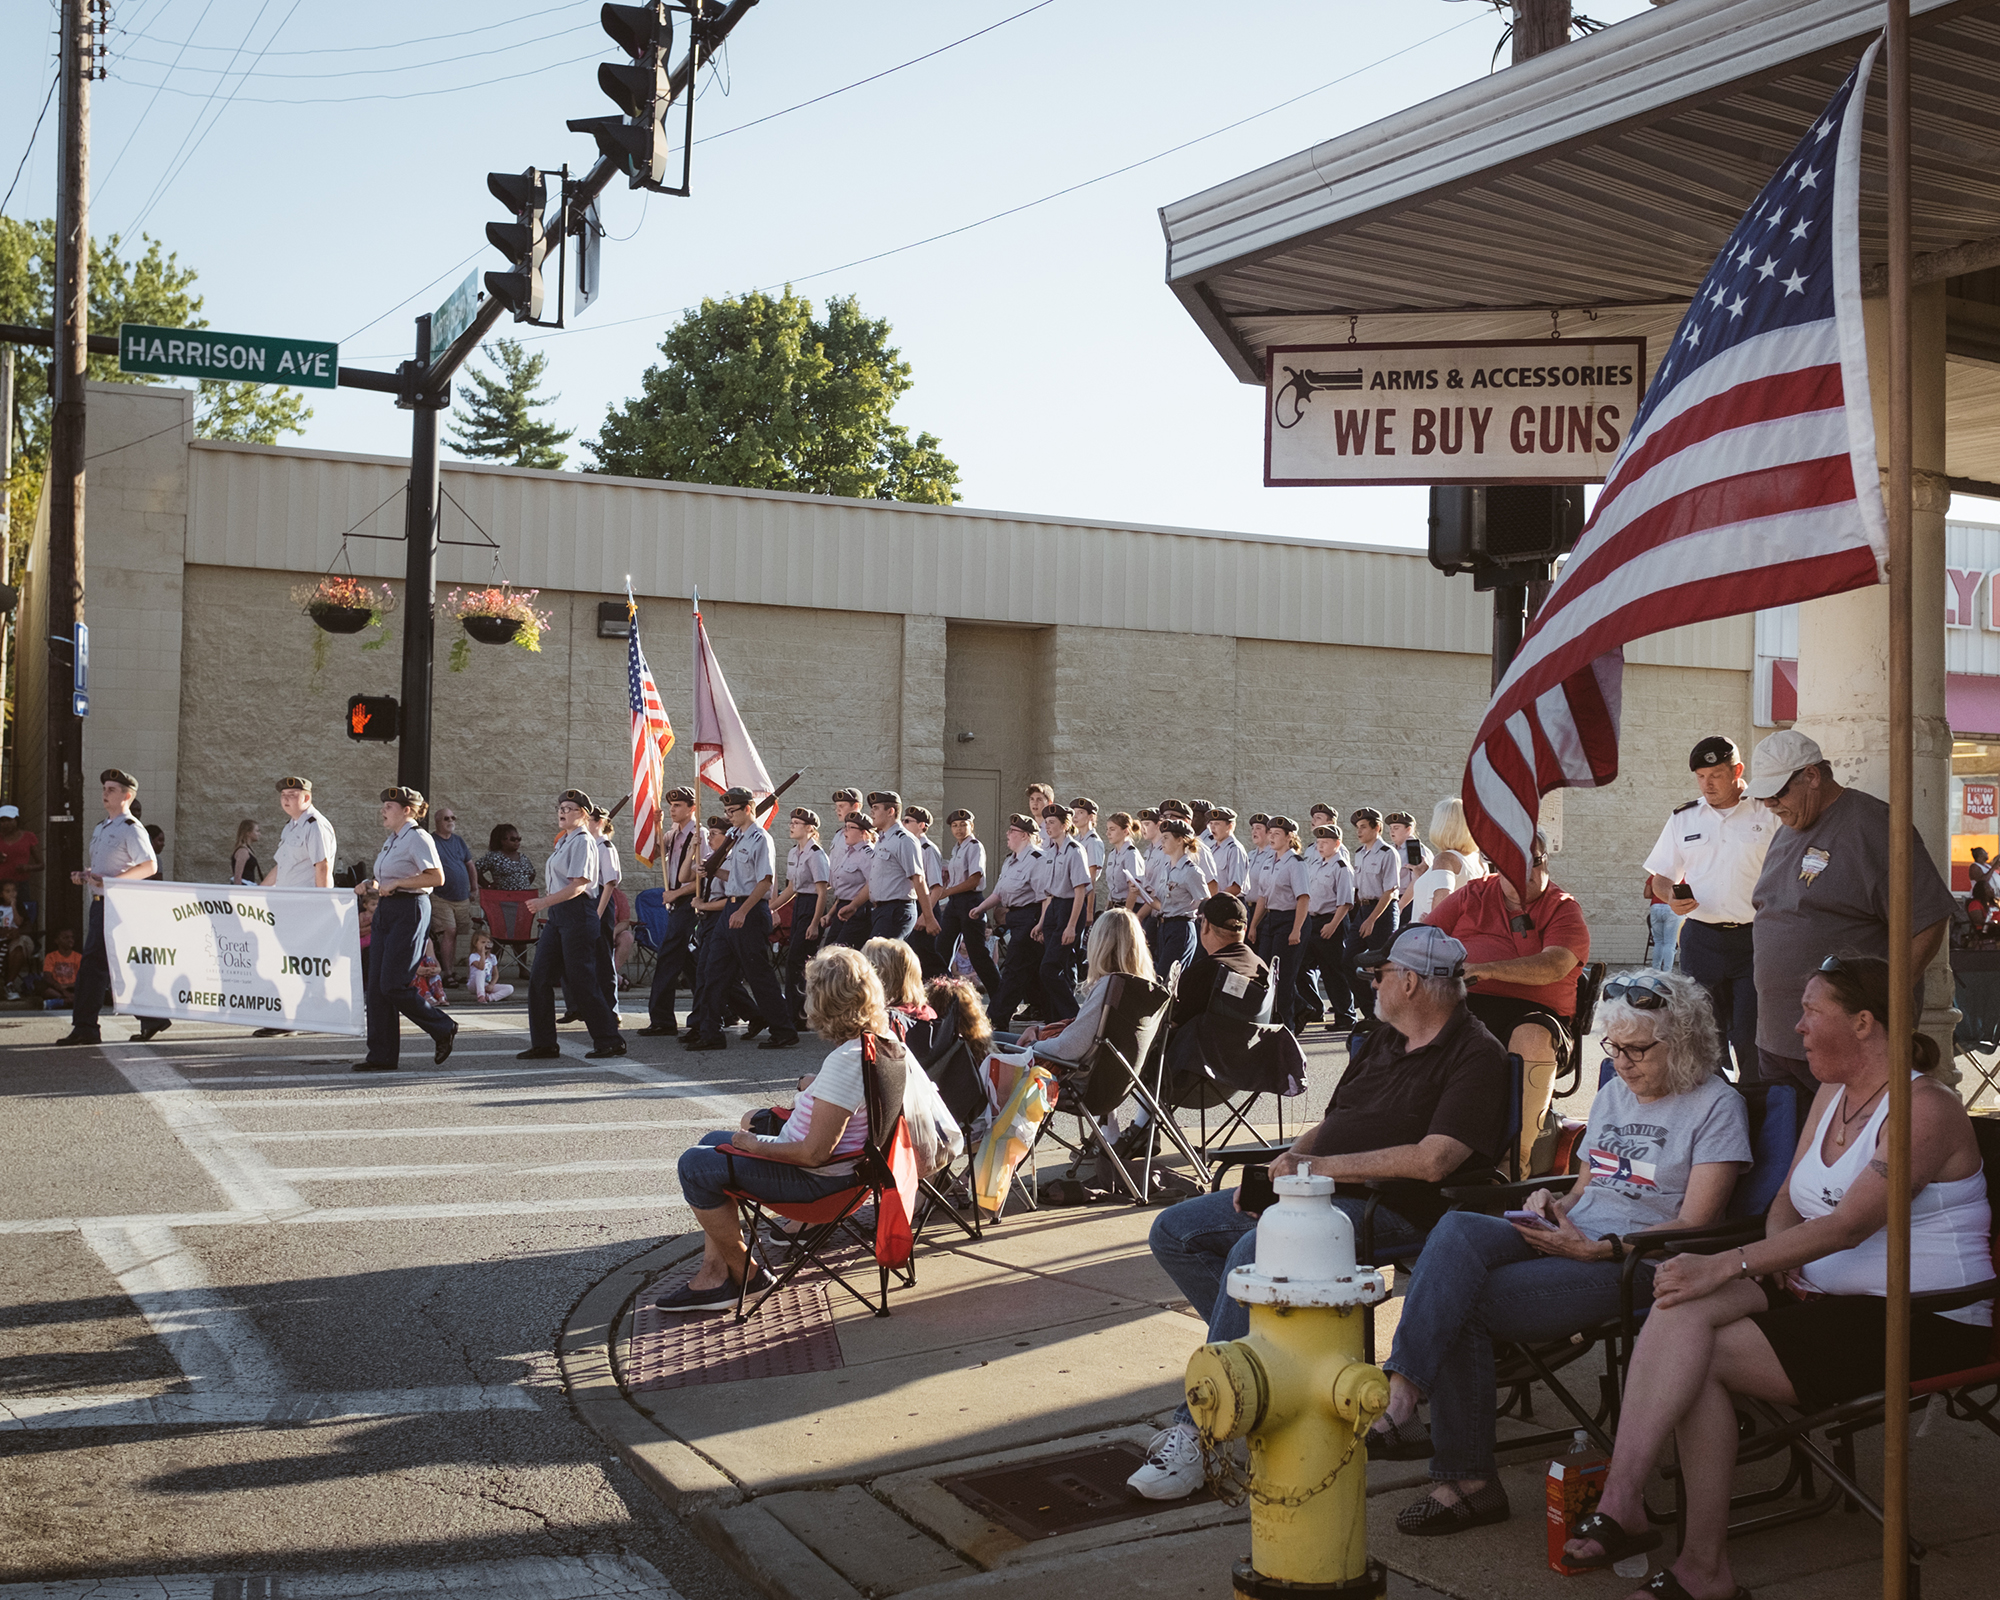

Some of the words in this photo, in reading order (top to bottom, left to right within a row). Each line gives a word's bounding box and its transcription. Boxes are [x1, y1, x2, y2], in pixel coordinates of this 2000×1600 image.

[127, 336, 266, 373] HARRISON
[276, 350, 330, 378] AVE
[1369, 370, 1439, 391] ARMS
[1446, 368, 1464, 389] &
[1470, 365, 1634, 389] ACCESSORIES
[1333, 408, 1397, 456] WE
[1411, 406, 1494, 455] BUY
[1508, 404, 1622, 454] GUNS
[1966, 805, 1994, 815] PRICES
[1967, 793, 1994, 806] LOW
[172, 900, 234, 922] DIAMOND
[236, 902, 276, 927] OAKS
[218, 935, 250, 953] Great
[126, 946, 177, 966] ARMY
[223, 951, 252, 969] Oaks
[281, 955, 332, 978] JROTC
[178, 989, 227, 1008] CAREER
[229, 993, 282, 1012] CAMPUS
